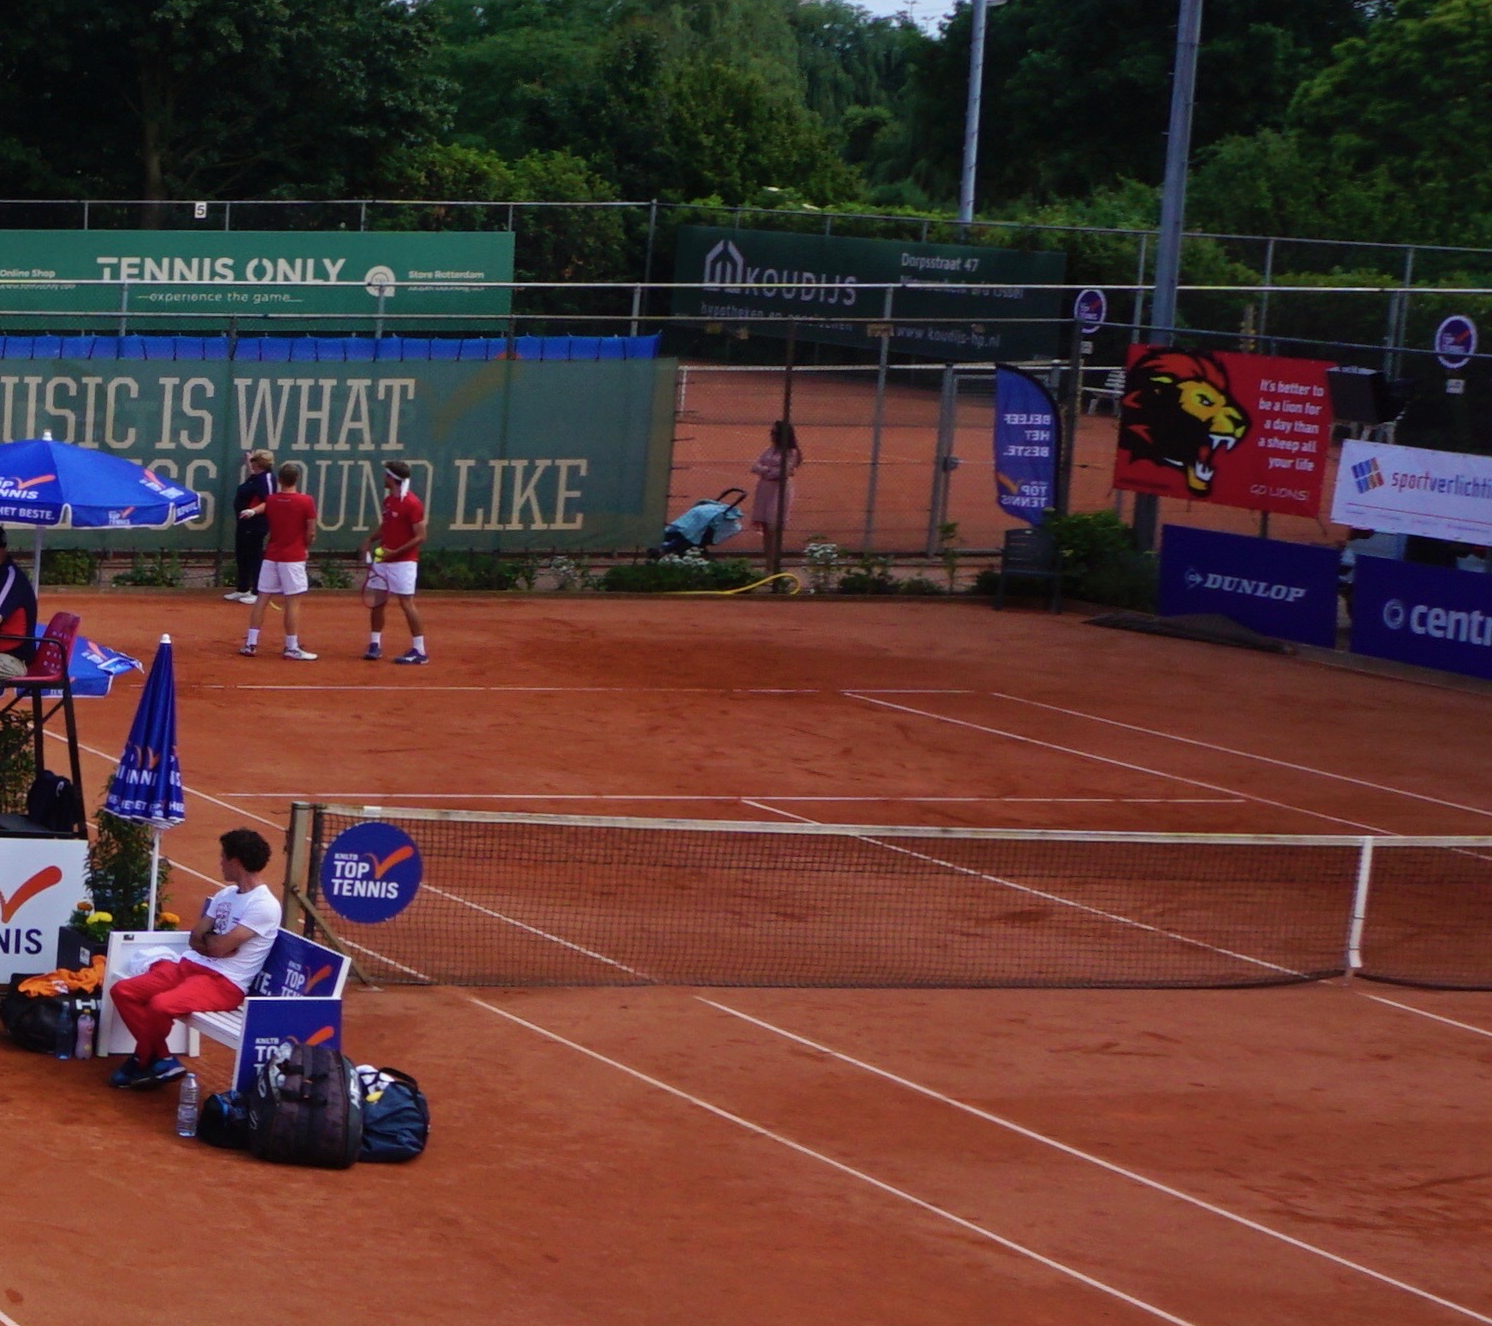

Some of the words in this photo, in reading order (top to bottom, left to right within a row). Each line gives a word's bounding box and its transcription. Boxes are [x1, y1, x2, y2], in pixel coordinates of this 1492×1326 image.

[196, 205, 206, 216] 5
[96, 257, 236, 282] TENNIS
[245, 258, 346, 283] ONLY
[900, 252, 961, 272] Dorpsstraat
[964, 257, 980, 272] 47
[0, 268, 28, 279] Online
[31, 268, 56, 280] Shop
[434, 270, 485, 280] Rotterdam
[745, 266, 858, 306] KOUDIJS
[149, 291, 223, 304] experience
[227, 291, 248, 303] the
[252, 293, 291, 305] game
[1312, 384, 1325, 397] to
[155, 377, 216, 451] IS
[233, 378, 416, 451] WHAT
[1258, 397, 1272, 411] be
[1282, 399, 1303, 414] lion
[1305, 401, 1323, 417] for
[1272, 418, 1292, 434] day
[1293, 420, 1319, 434] than
[1266, 436, 1299, 454] sheep
[1301, 439, 1317, 453] all
[1268, 457, 1295, 470] your
[1295, 457, 1315, 471] life
[449, 459, 588, 531] LIKE
[19, 507, 56, 521] BESTE.
[1203, 572, 1307, 602] DUNLOP
[333, 861, 370, 879] TOP
[331, 879, 400, 899] TENNIS
[285, 968, 306, 989] TOP
[255, 1046, 279, 1062] TO
